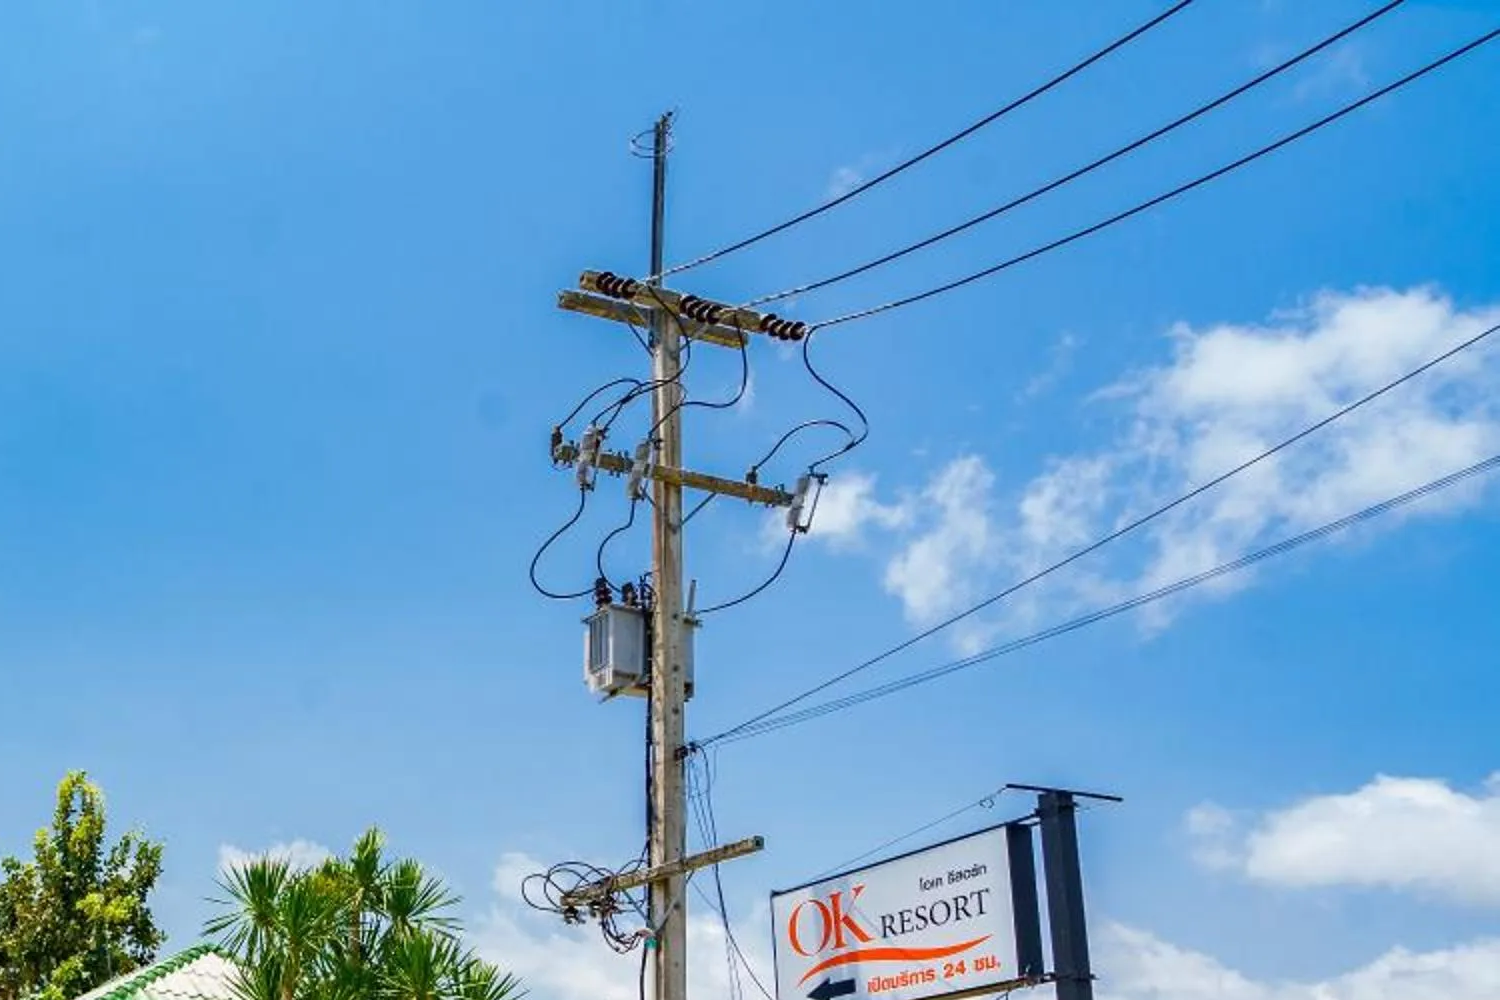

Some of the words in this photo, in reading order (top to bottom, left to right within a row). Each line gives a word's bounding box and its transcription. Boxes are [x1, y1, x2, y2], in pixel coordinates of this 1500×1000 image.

[788, 884, 873, 957] OK
[880, 889, 990, 939] RESORT
[867, 968, 936, 993] เปิดบริการ
[943, 960, 966, 979] 24
